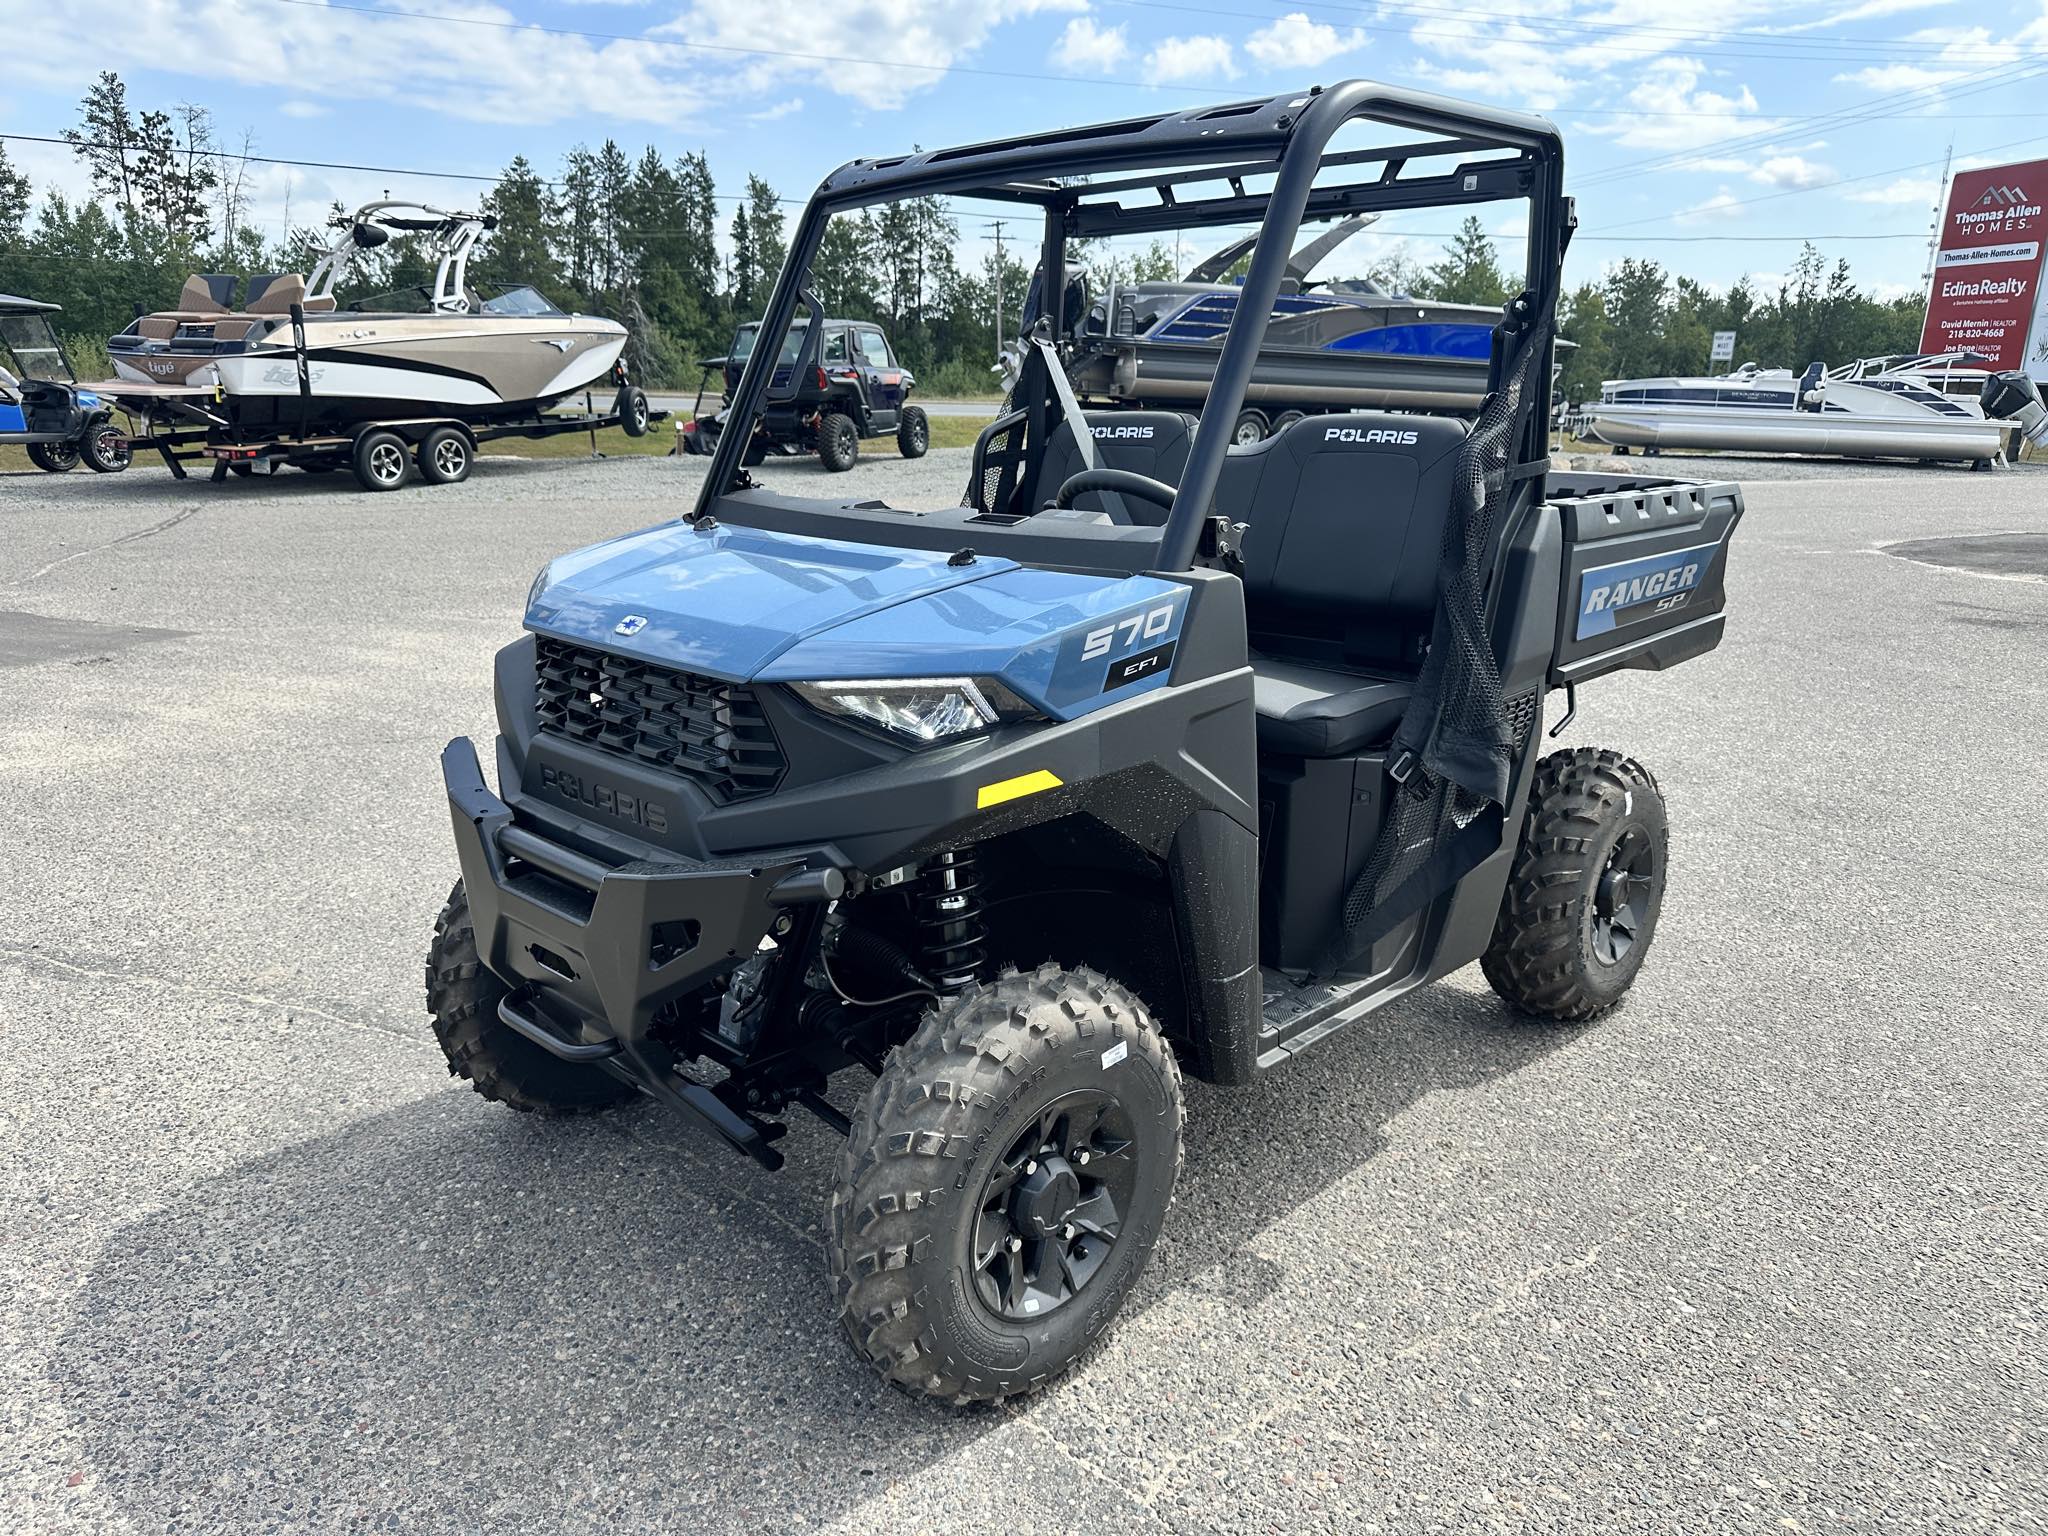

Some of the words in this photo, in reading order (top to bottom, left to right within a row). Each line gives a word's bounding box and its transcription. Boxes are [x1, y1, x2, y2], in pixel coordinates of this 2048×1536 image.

[1955, 210, 2004, 224] Thomas
[2005, 205, 2041, 218] Allen
[1961, 218, 2026, 235] HOMES
[1944, 247, 2031, 262] Thomas-Allen-Homes.com
[1941, 319, 1962, 329] David
[1962, 319, 1989, 328] Mernin
[1948, 328, 2005, 339] 218-820-4668
[1943, 344, 1957, 352] Joe
[148, 361, 175, 376] tigé
[1087, 426, 1154, 438] POLARIS
[1324, 428, 1419, 445] POLARIS
[1584, 563, 1698, 615] RANGER
[1654, 592, 1686, 613] SP
[1080, 604, 1174, 662] 570
[1123, 655, 1158, 677] EFI
[539, 762, 669, 834] POLARIS
